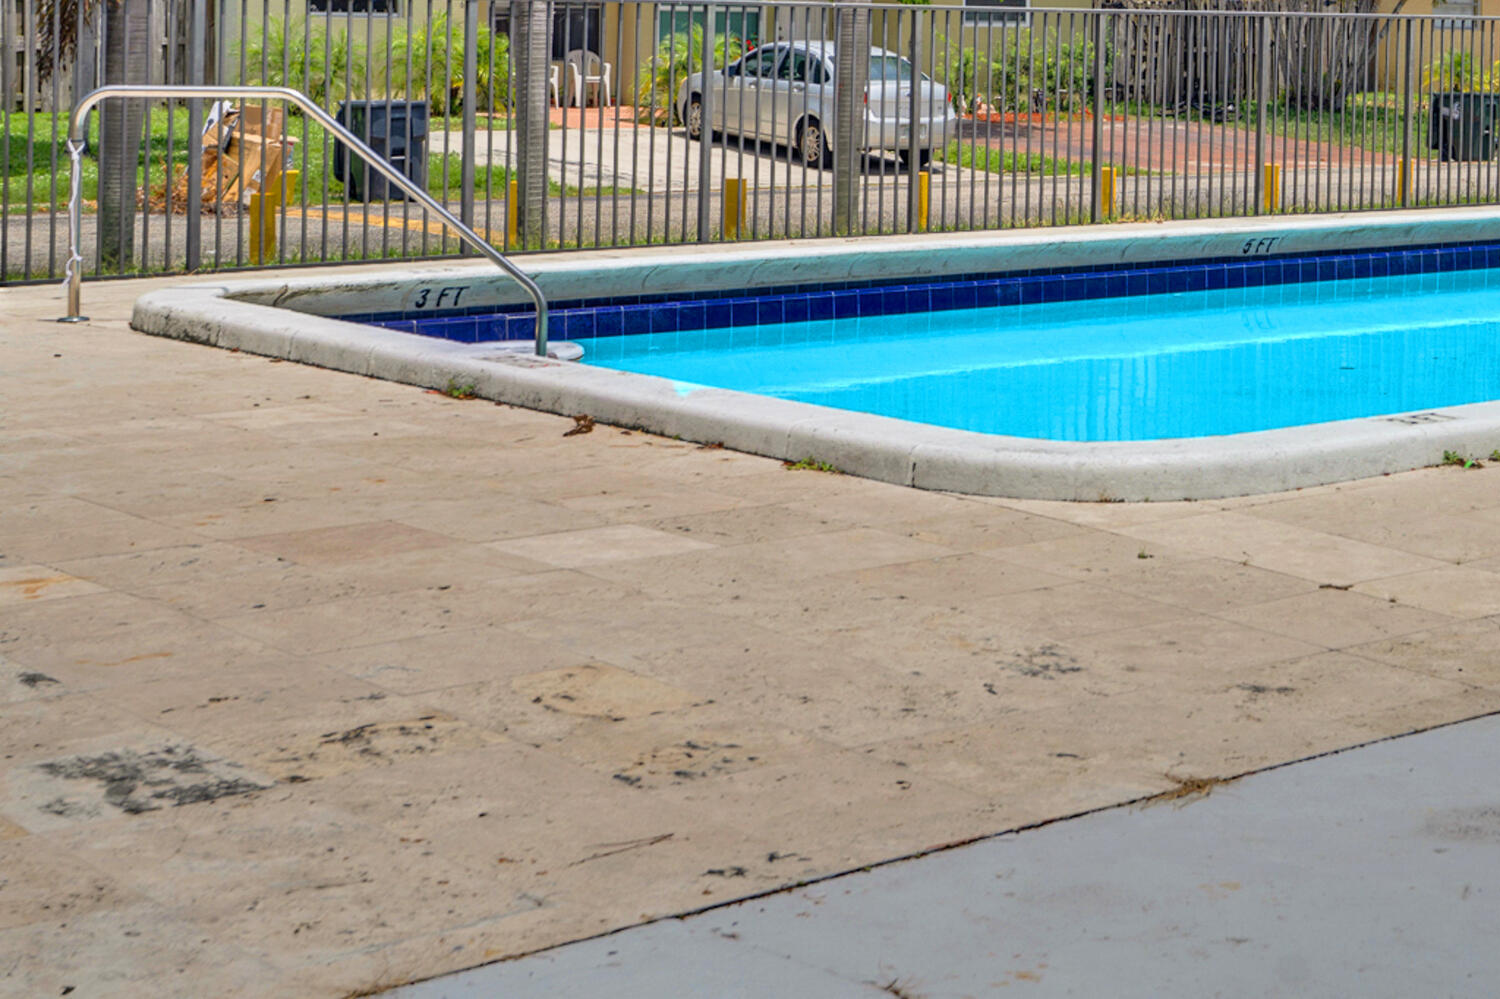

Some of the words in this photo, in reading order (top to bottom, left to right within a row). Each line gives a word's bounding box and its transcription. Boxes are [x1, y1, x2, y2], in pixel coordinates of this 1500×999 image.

[1242, 238, 1257, 254] 5
[1255, 236, 1280, 253] FT
[415, 288, 431, 308] 3
[436, 286, 470, 307] FT
